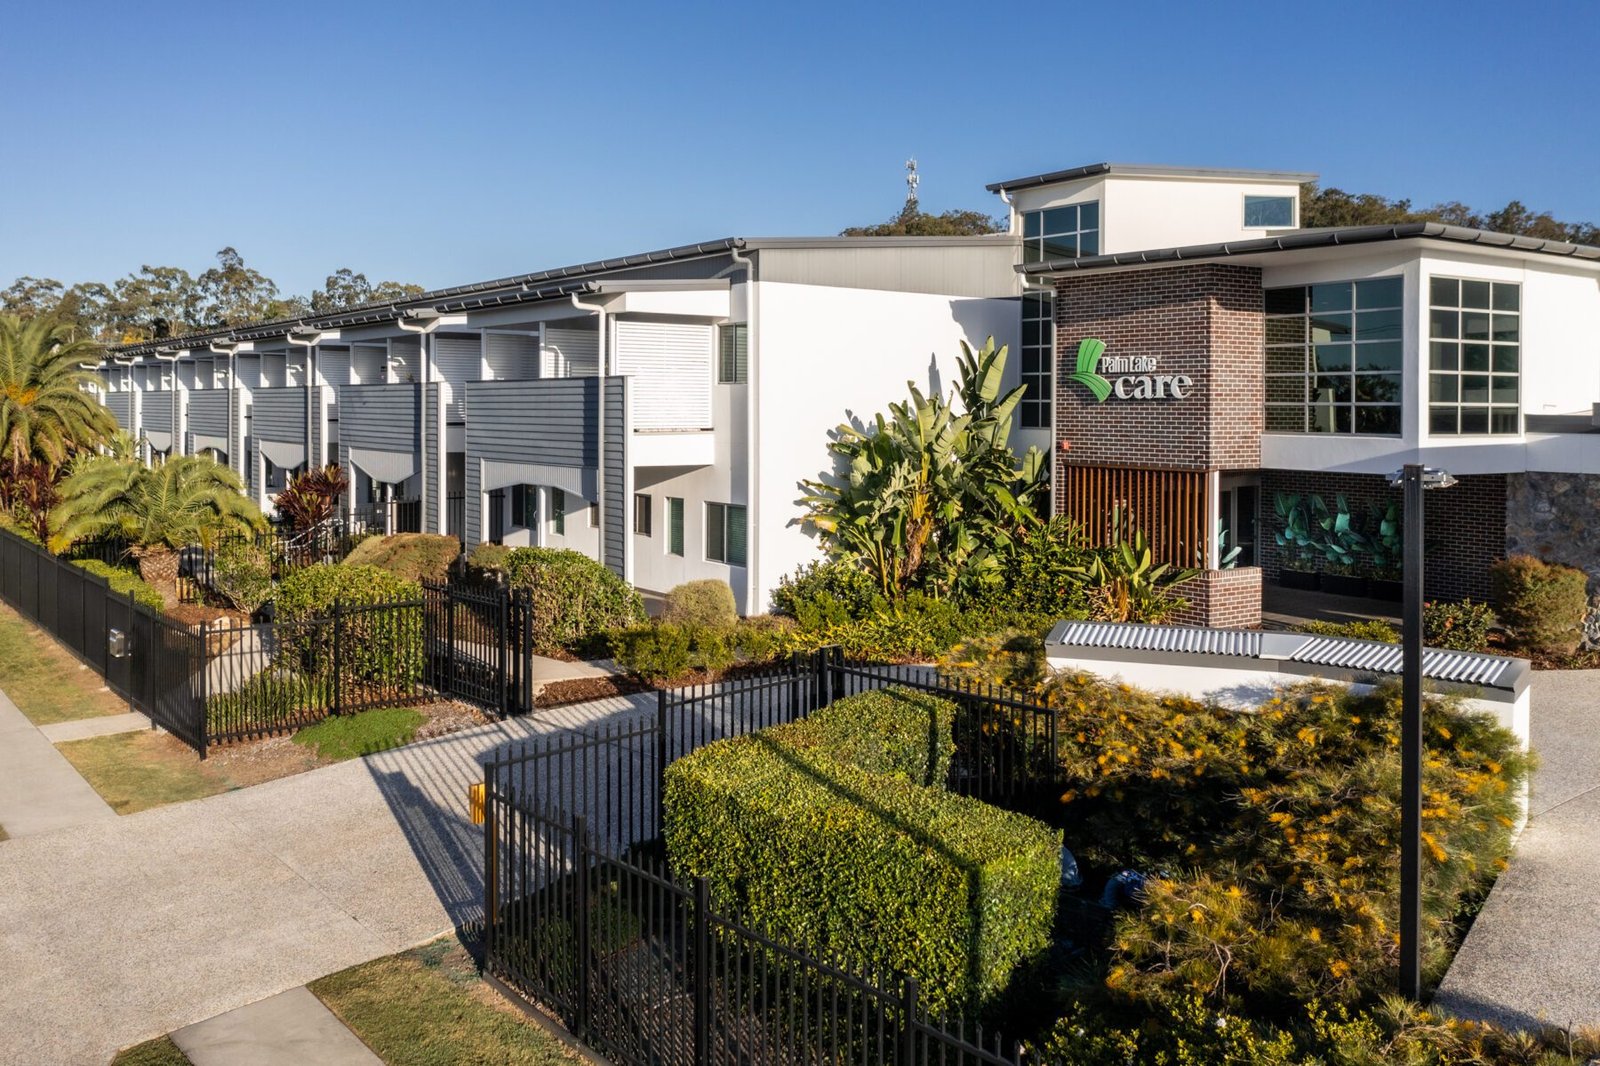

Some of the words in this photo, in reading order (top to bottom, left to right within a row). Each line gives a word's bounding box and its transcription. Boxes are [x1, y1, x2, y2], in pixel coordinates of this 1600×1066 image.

[1102, 356, 1128, 373] Palm
[1129, 356, 1157, 372] Lake
[1114, 375, 1193, 400] care
